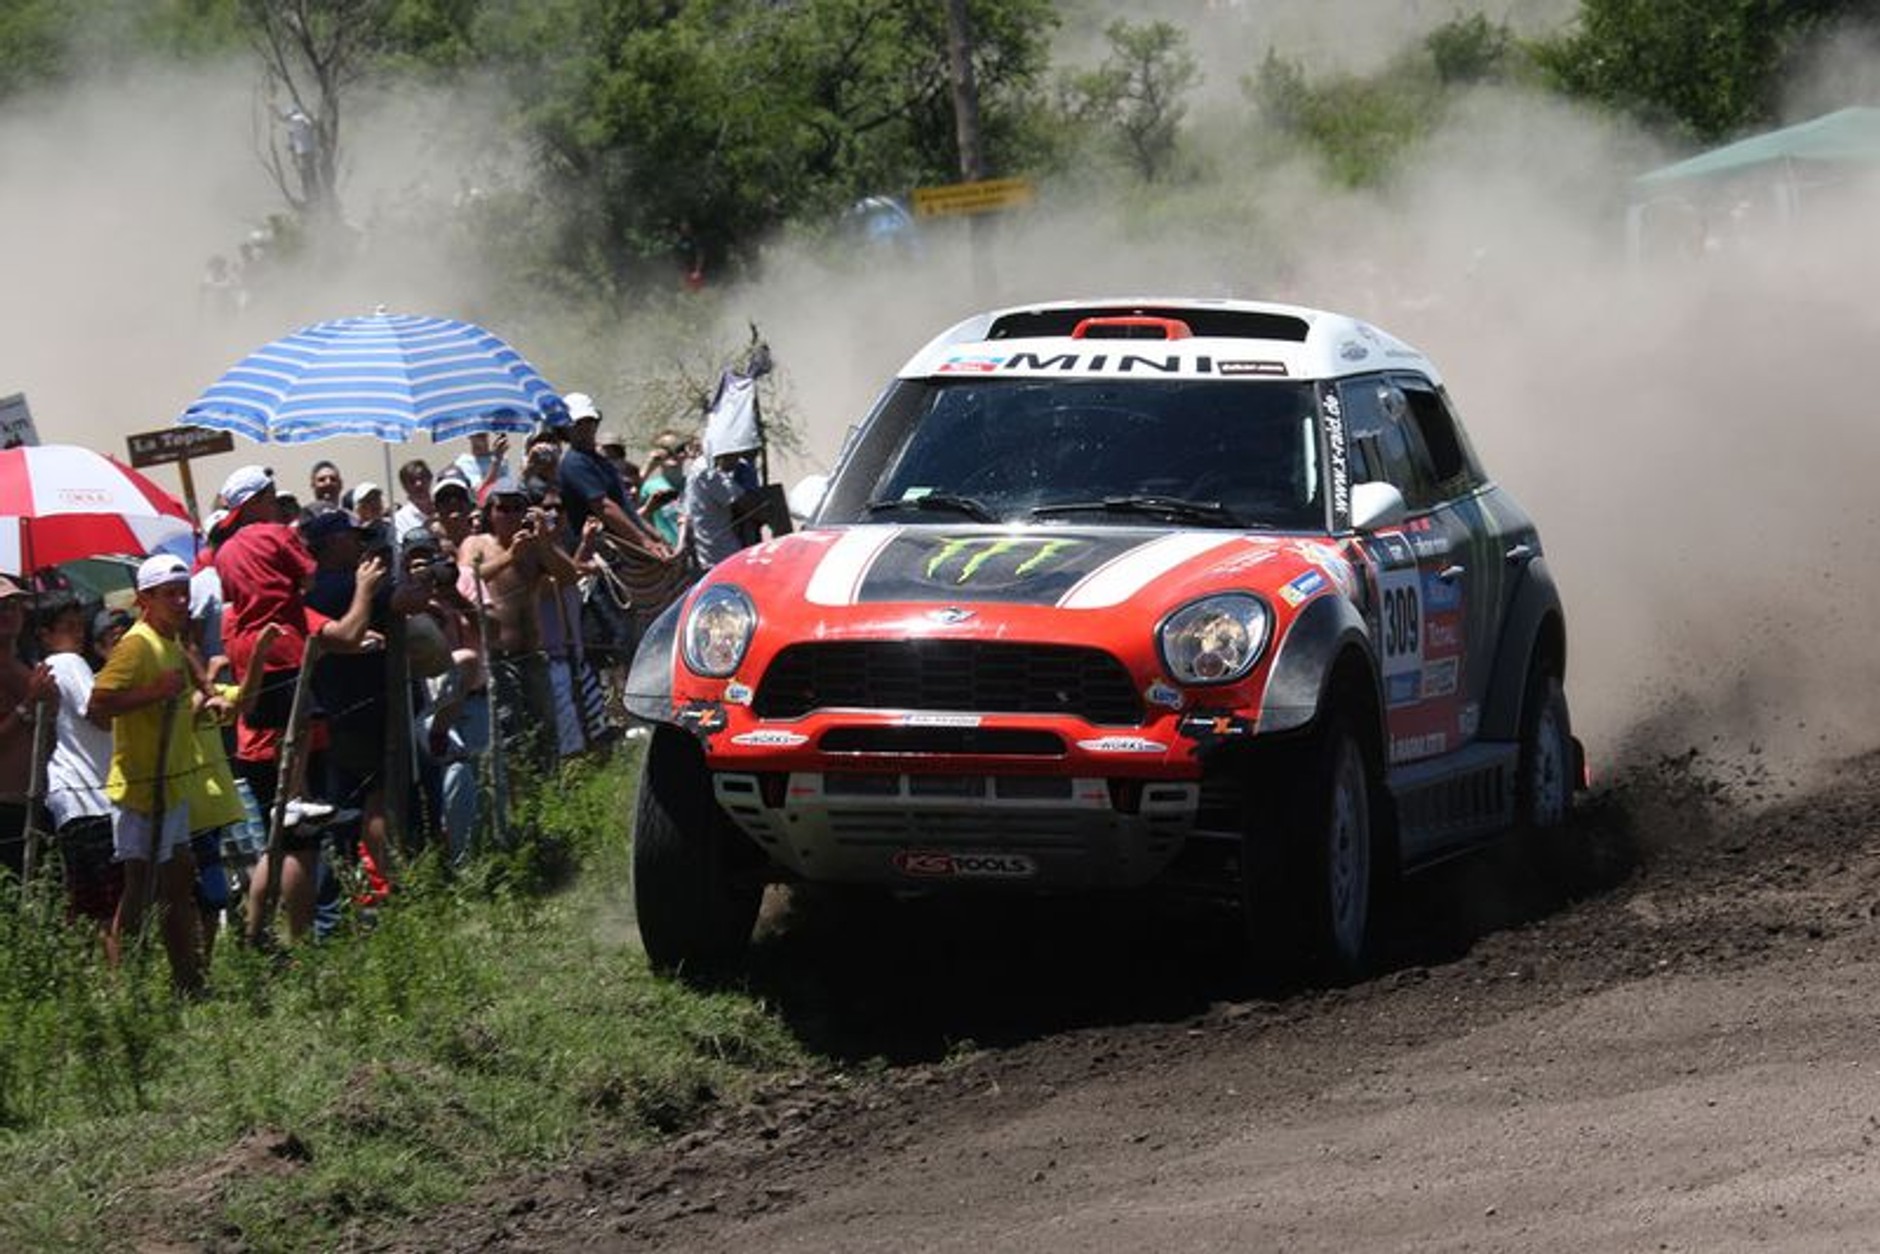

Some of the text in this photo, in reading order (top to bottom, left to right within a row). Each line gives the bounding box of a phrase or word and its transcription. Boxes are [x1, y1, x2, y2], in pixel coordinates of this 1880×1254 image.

[1004, 353, 1212, 373] MINI
[1384, 585, 1420, 657] 309
[952, 856, 1027, 874] TOOLS
